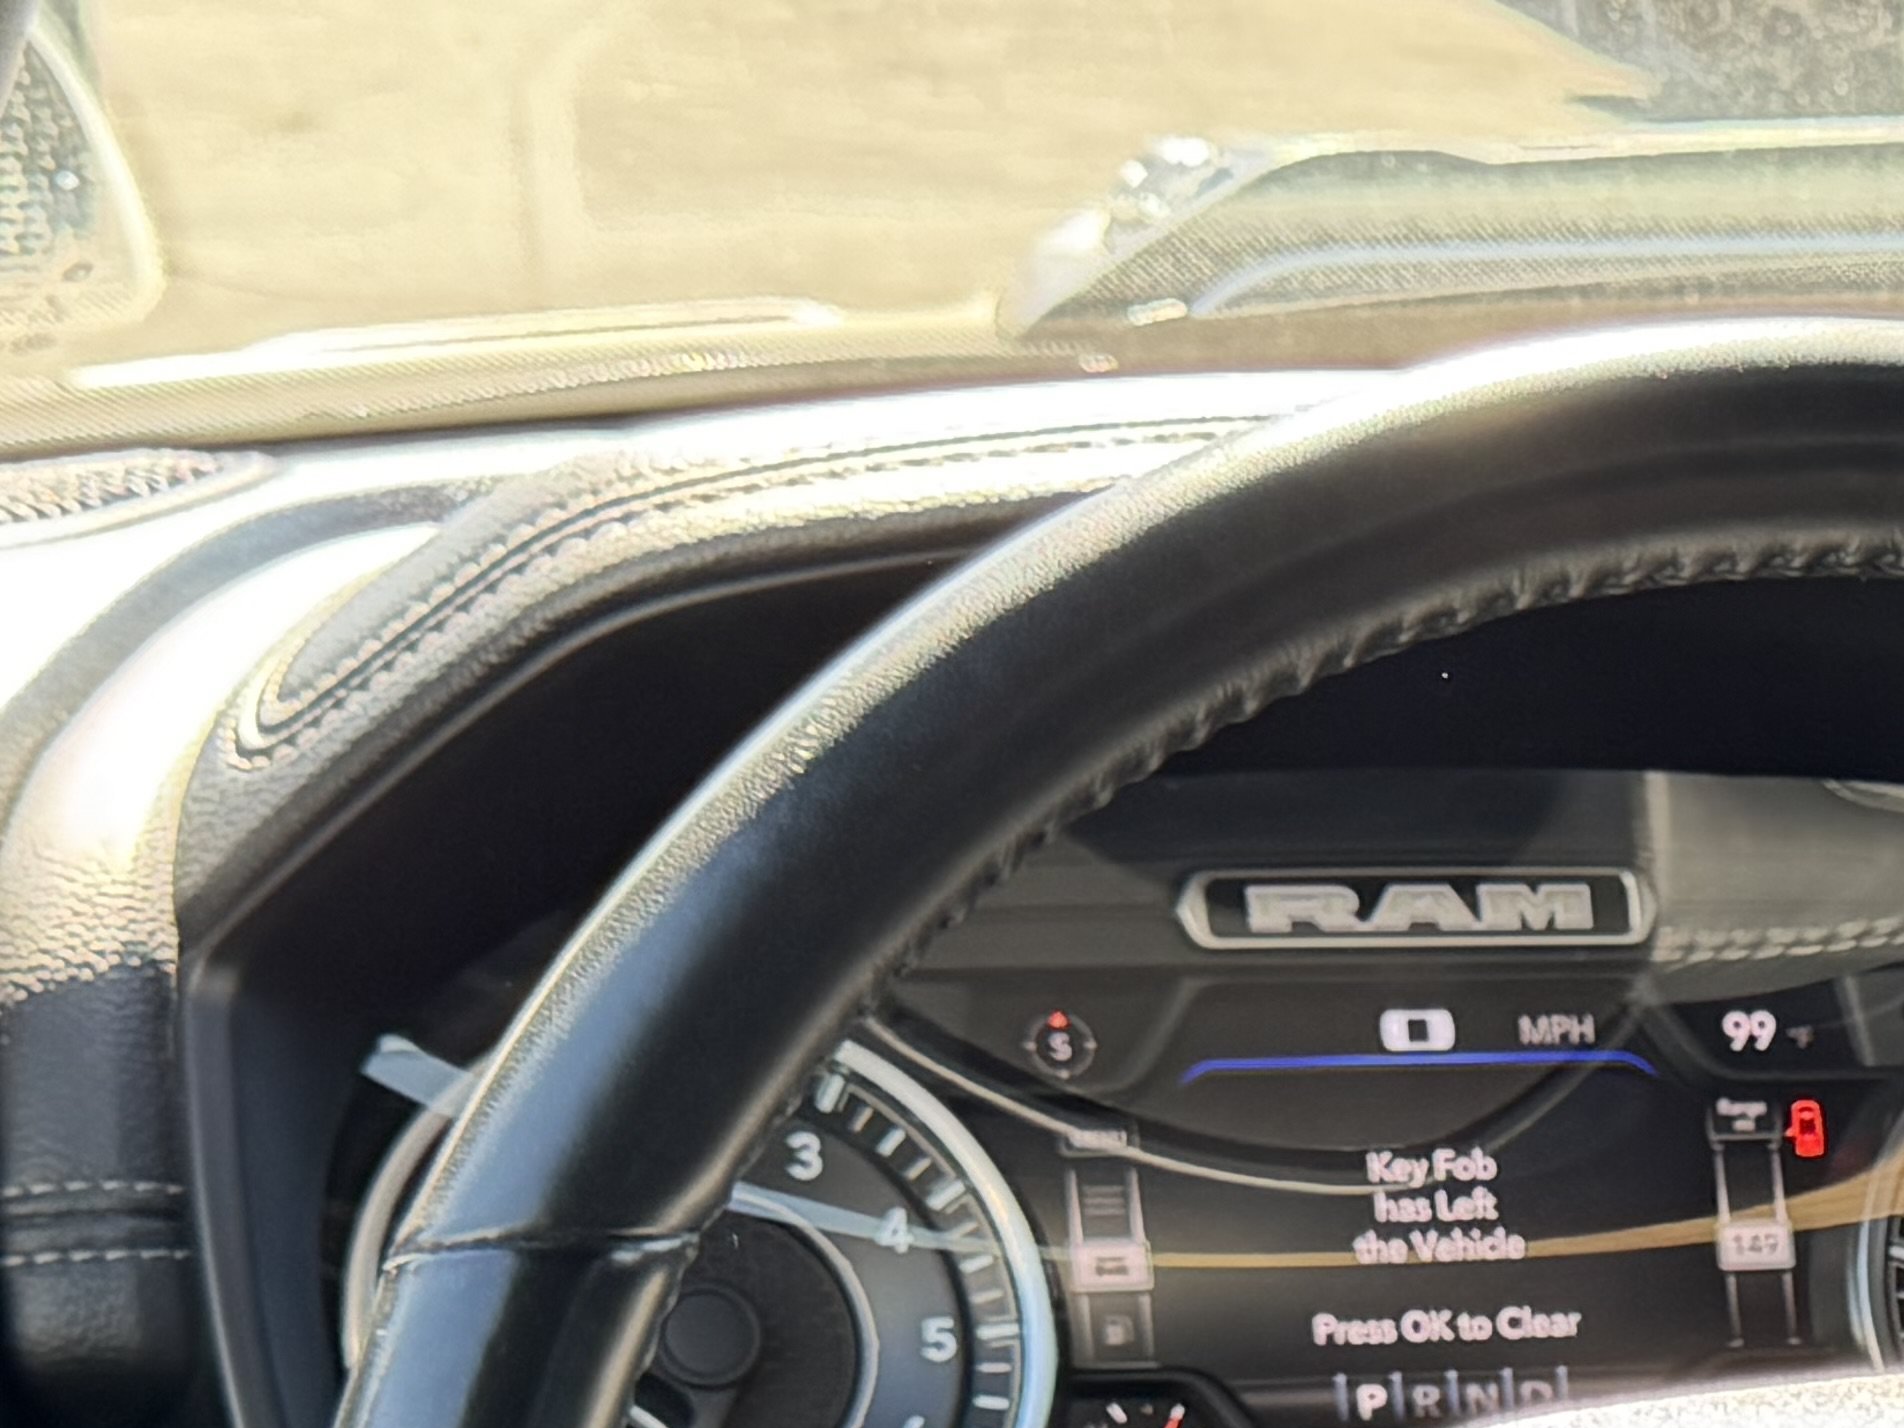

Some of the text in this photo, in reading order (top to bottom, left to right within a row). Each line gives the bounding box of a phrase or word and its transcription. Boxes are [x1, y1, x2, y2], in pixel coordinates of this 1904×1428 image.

[1244, 883, 1595, 933] RAM
[1049, 1031, 1073, 1061] S
[1380, 1009, 1596, 1052] 0 MPH
[1722, 1009, 1777, 1052] 99
[785, 1131, 824, 1181] 3
[1365, 1147, 1498, 1188] Key Fob
[1374, 1186, 1499, 1223] has Left
[874, 1207, 914, 1253] 4
[1353, 1226, 1527, 1265] the Vehicle
[920, 1316, 958, 1362] 5
[1312, 1304, 1583, 1346] Press OK to Clear
[1355, 1383, 1388, 1421] P
[1411, 1384, 1441, 1418] R
